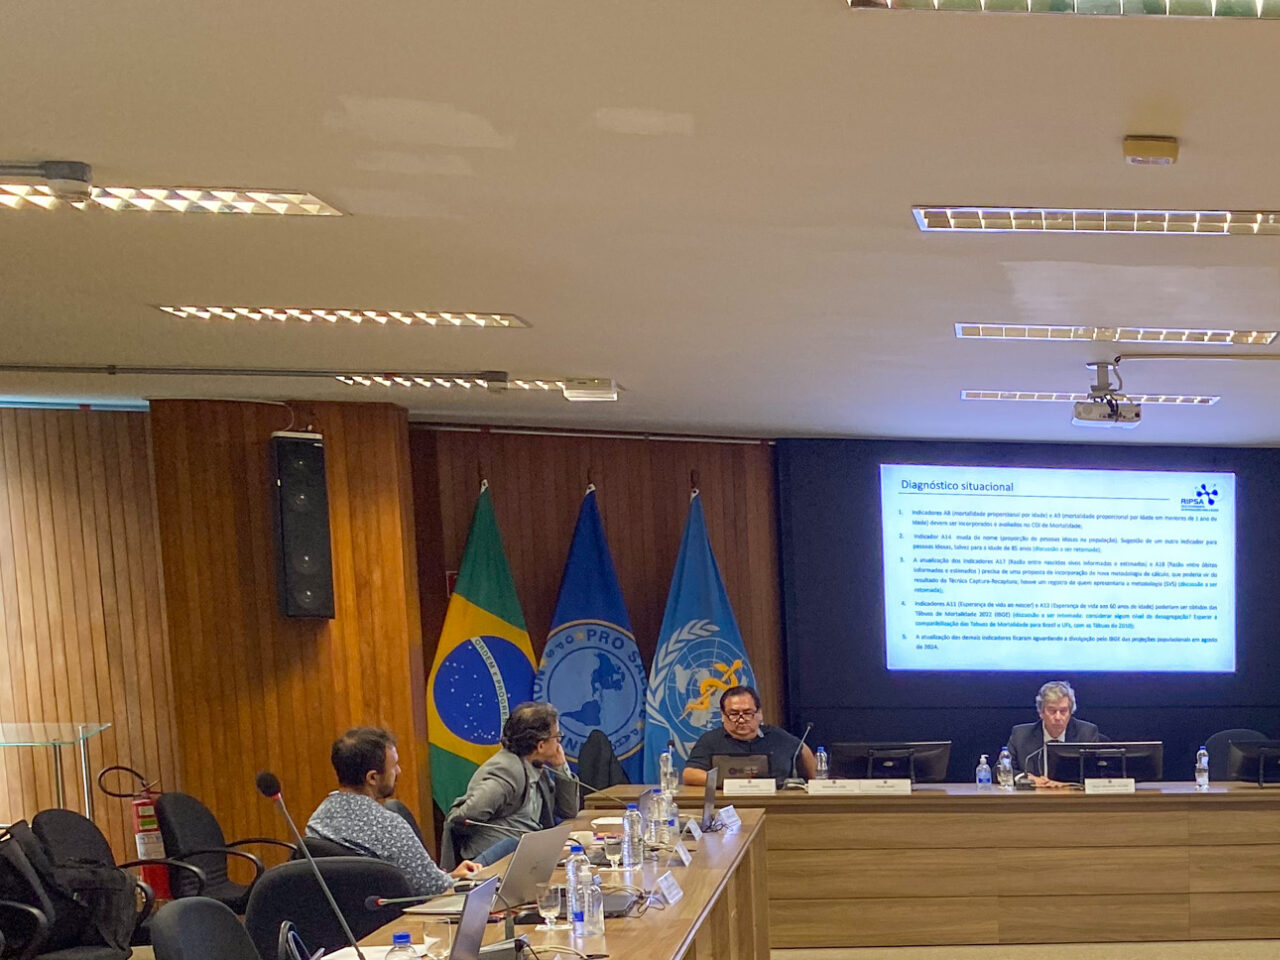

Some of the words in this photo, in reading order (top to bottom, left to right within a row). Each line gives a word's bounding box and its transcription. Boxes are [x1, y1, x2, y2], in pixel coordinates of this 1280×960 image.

[901, 479, 959, 491] Diagnóstico
[960, 481, 1014, 492] situacional
[586, 629, 625, 649] PRO
[474, 638, 496, 669] ORDEM
